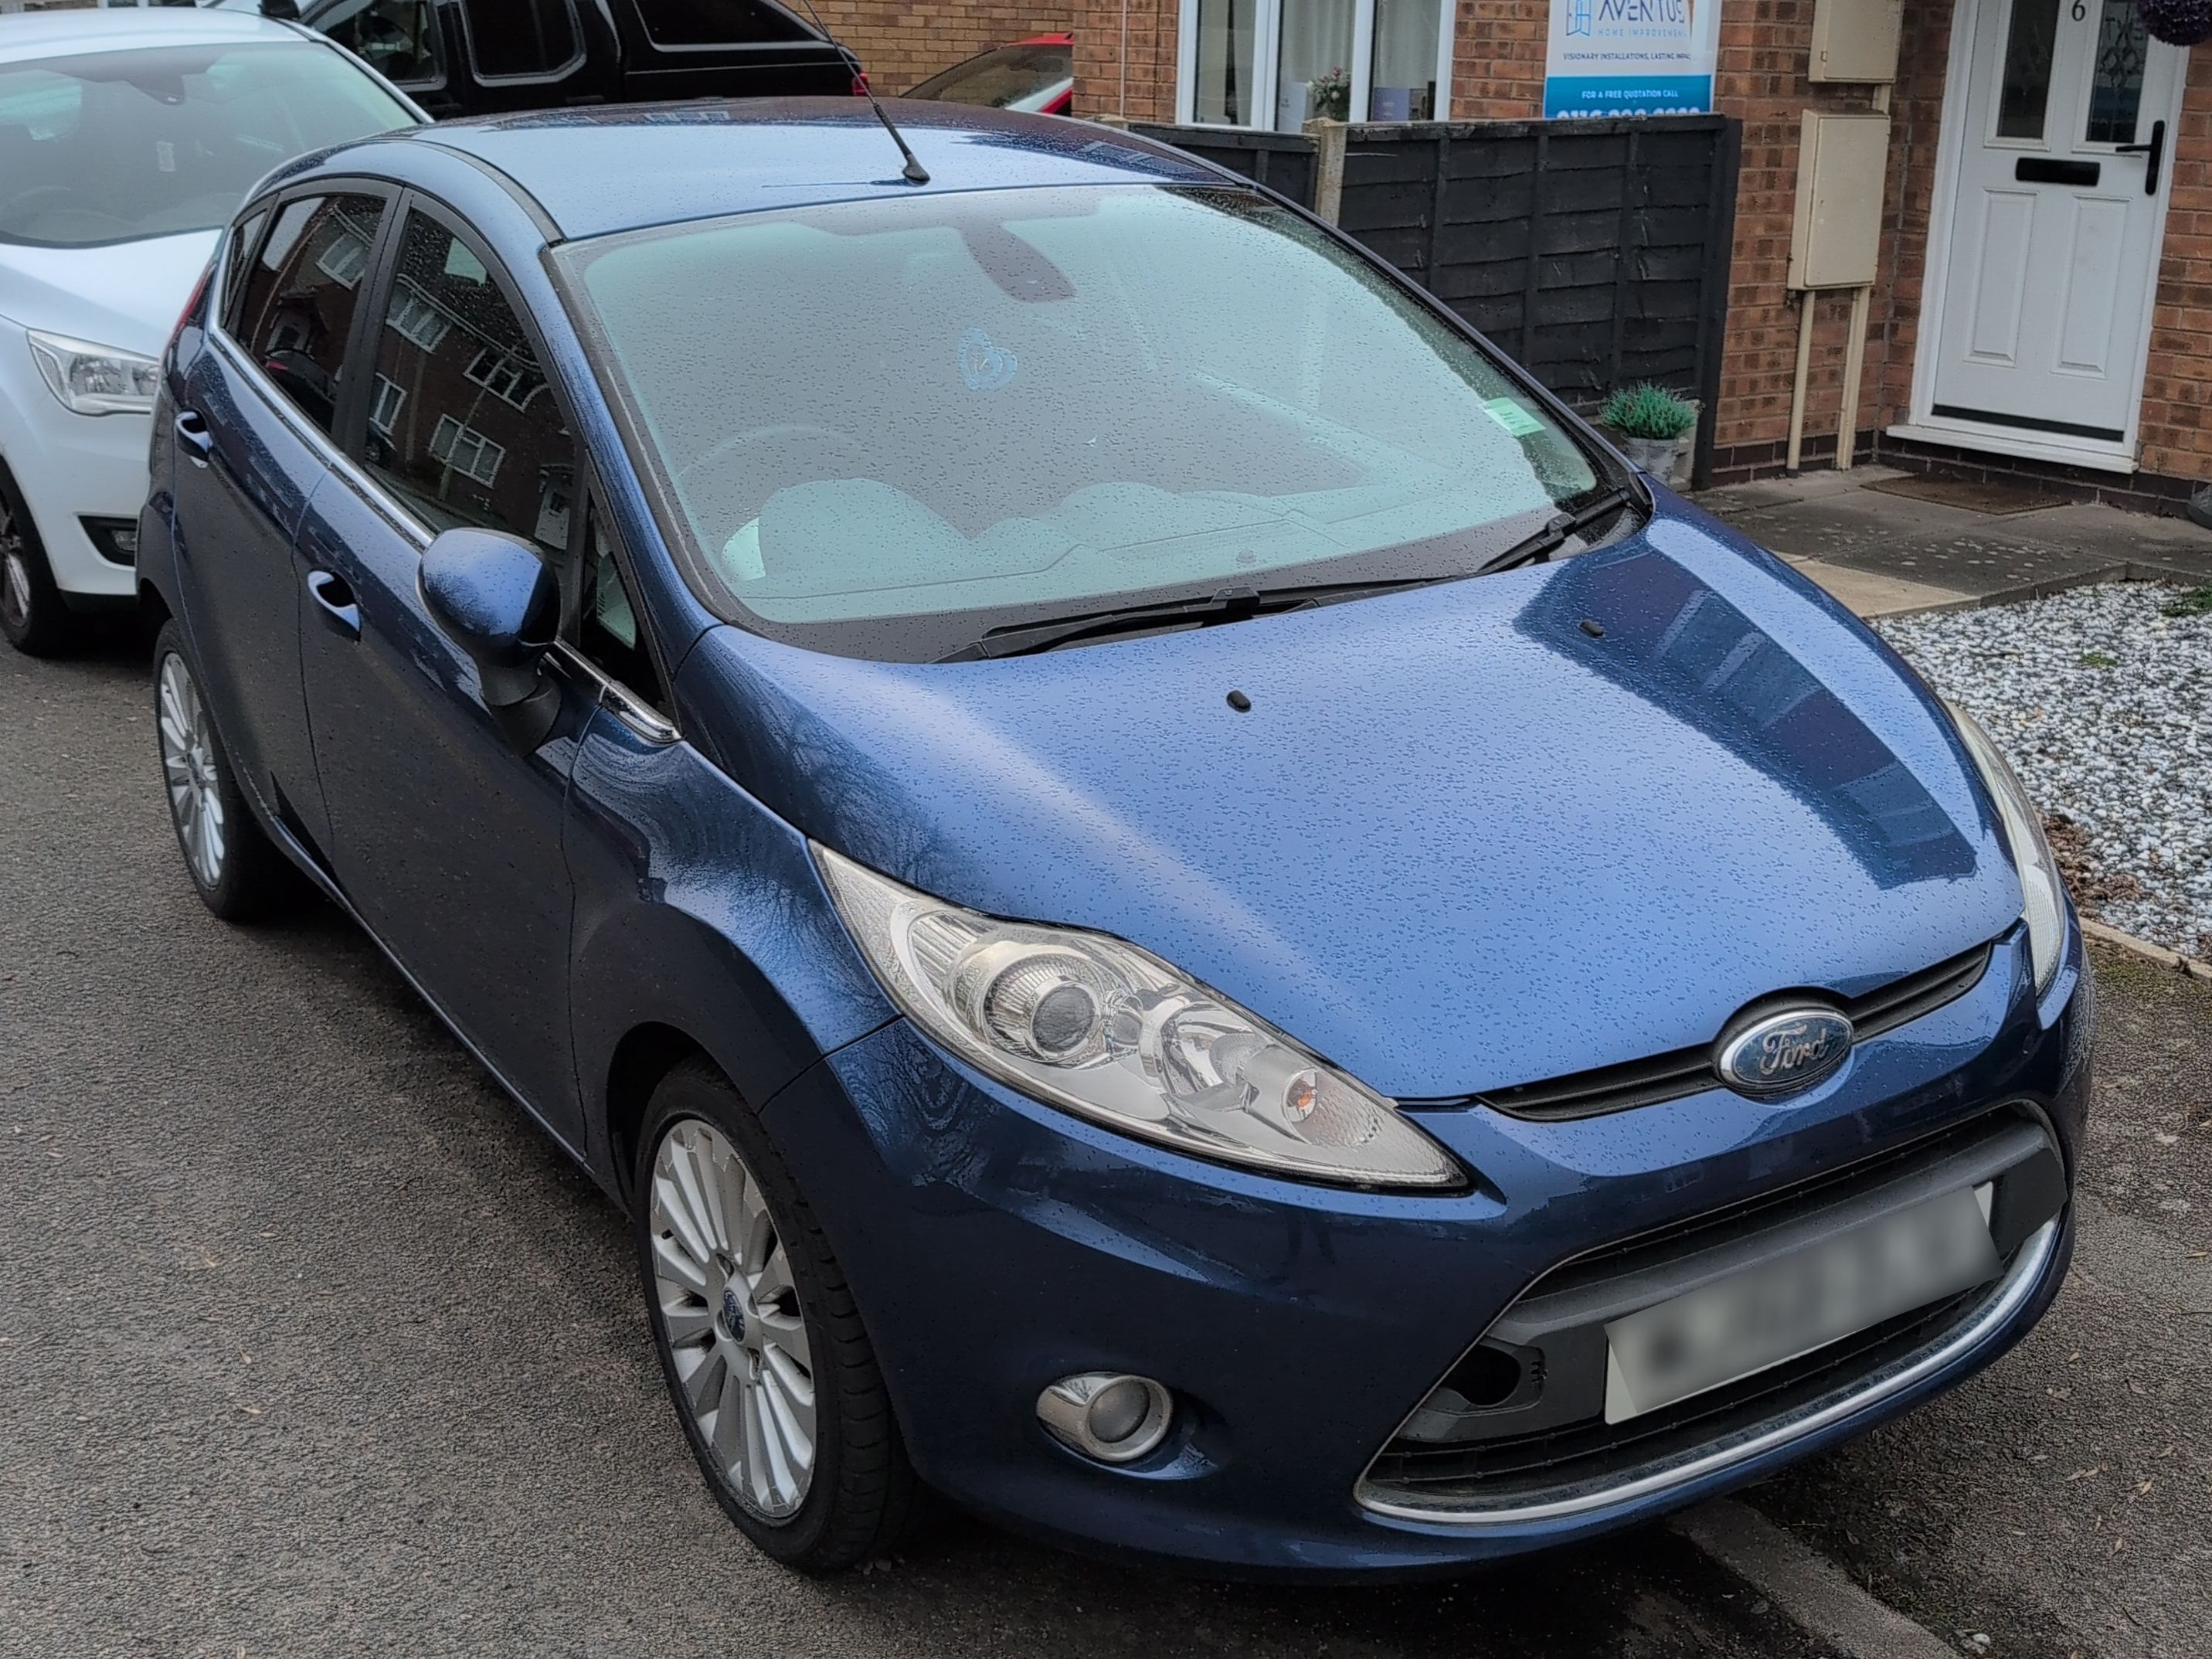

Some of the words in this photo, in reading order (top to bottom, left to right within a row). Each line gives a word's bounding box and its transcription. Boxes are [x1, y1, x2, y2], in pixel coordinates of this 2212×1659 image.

[1599, 0, 1684, 23] AVENTUS
[2071, 0, 2086, 21] 6
[1598, 29, 1624, 37] HOME
[1582, 90, 1596, 99] FOR
[1605, 90, 1622, 98] FREE
[1623, 90, 1662, 99] QUOTATION
[1663, 89, 1679, 97] CALL
[1759, 1024, 1829, 1076] Ford
